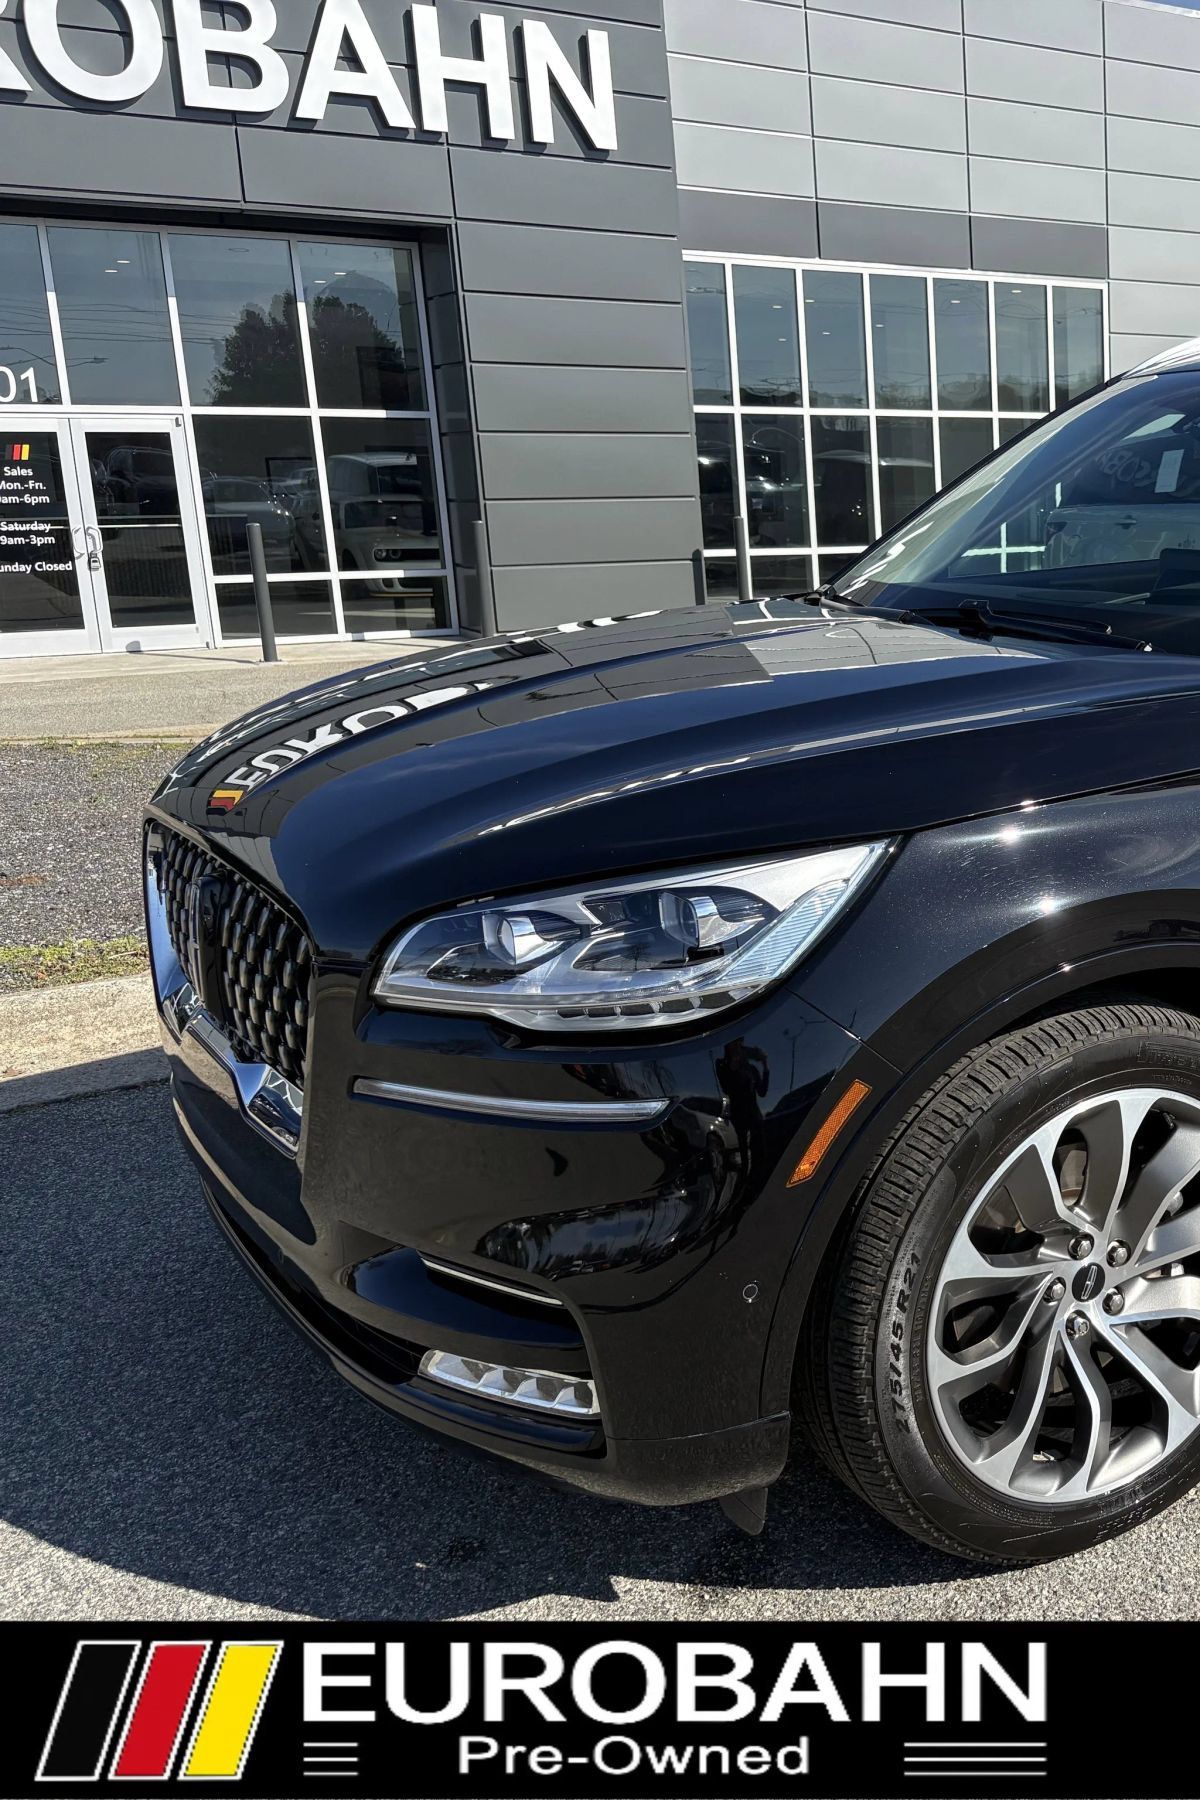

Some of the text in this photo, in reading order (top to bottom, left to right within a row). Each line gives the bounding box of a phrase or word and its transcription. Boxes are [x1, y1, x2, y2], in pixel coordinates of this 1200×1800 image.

[3, 466, 33, 476] Sales
[0, 494, 50, 506] am-6pm
[0, 521, 51, 533] Saturday
[0, 535, 56, 546] 9am-3pm
[34, 561, 73, 572] Closed
[889, 1252, 921, 1434] 275/45 R21
